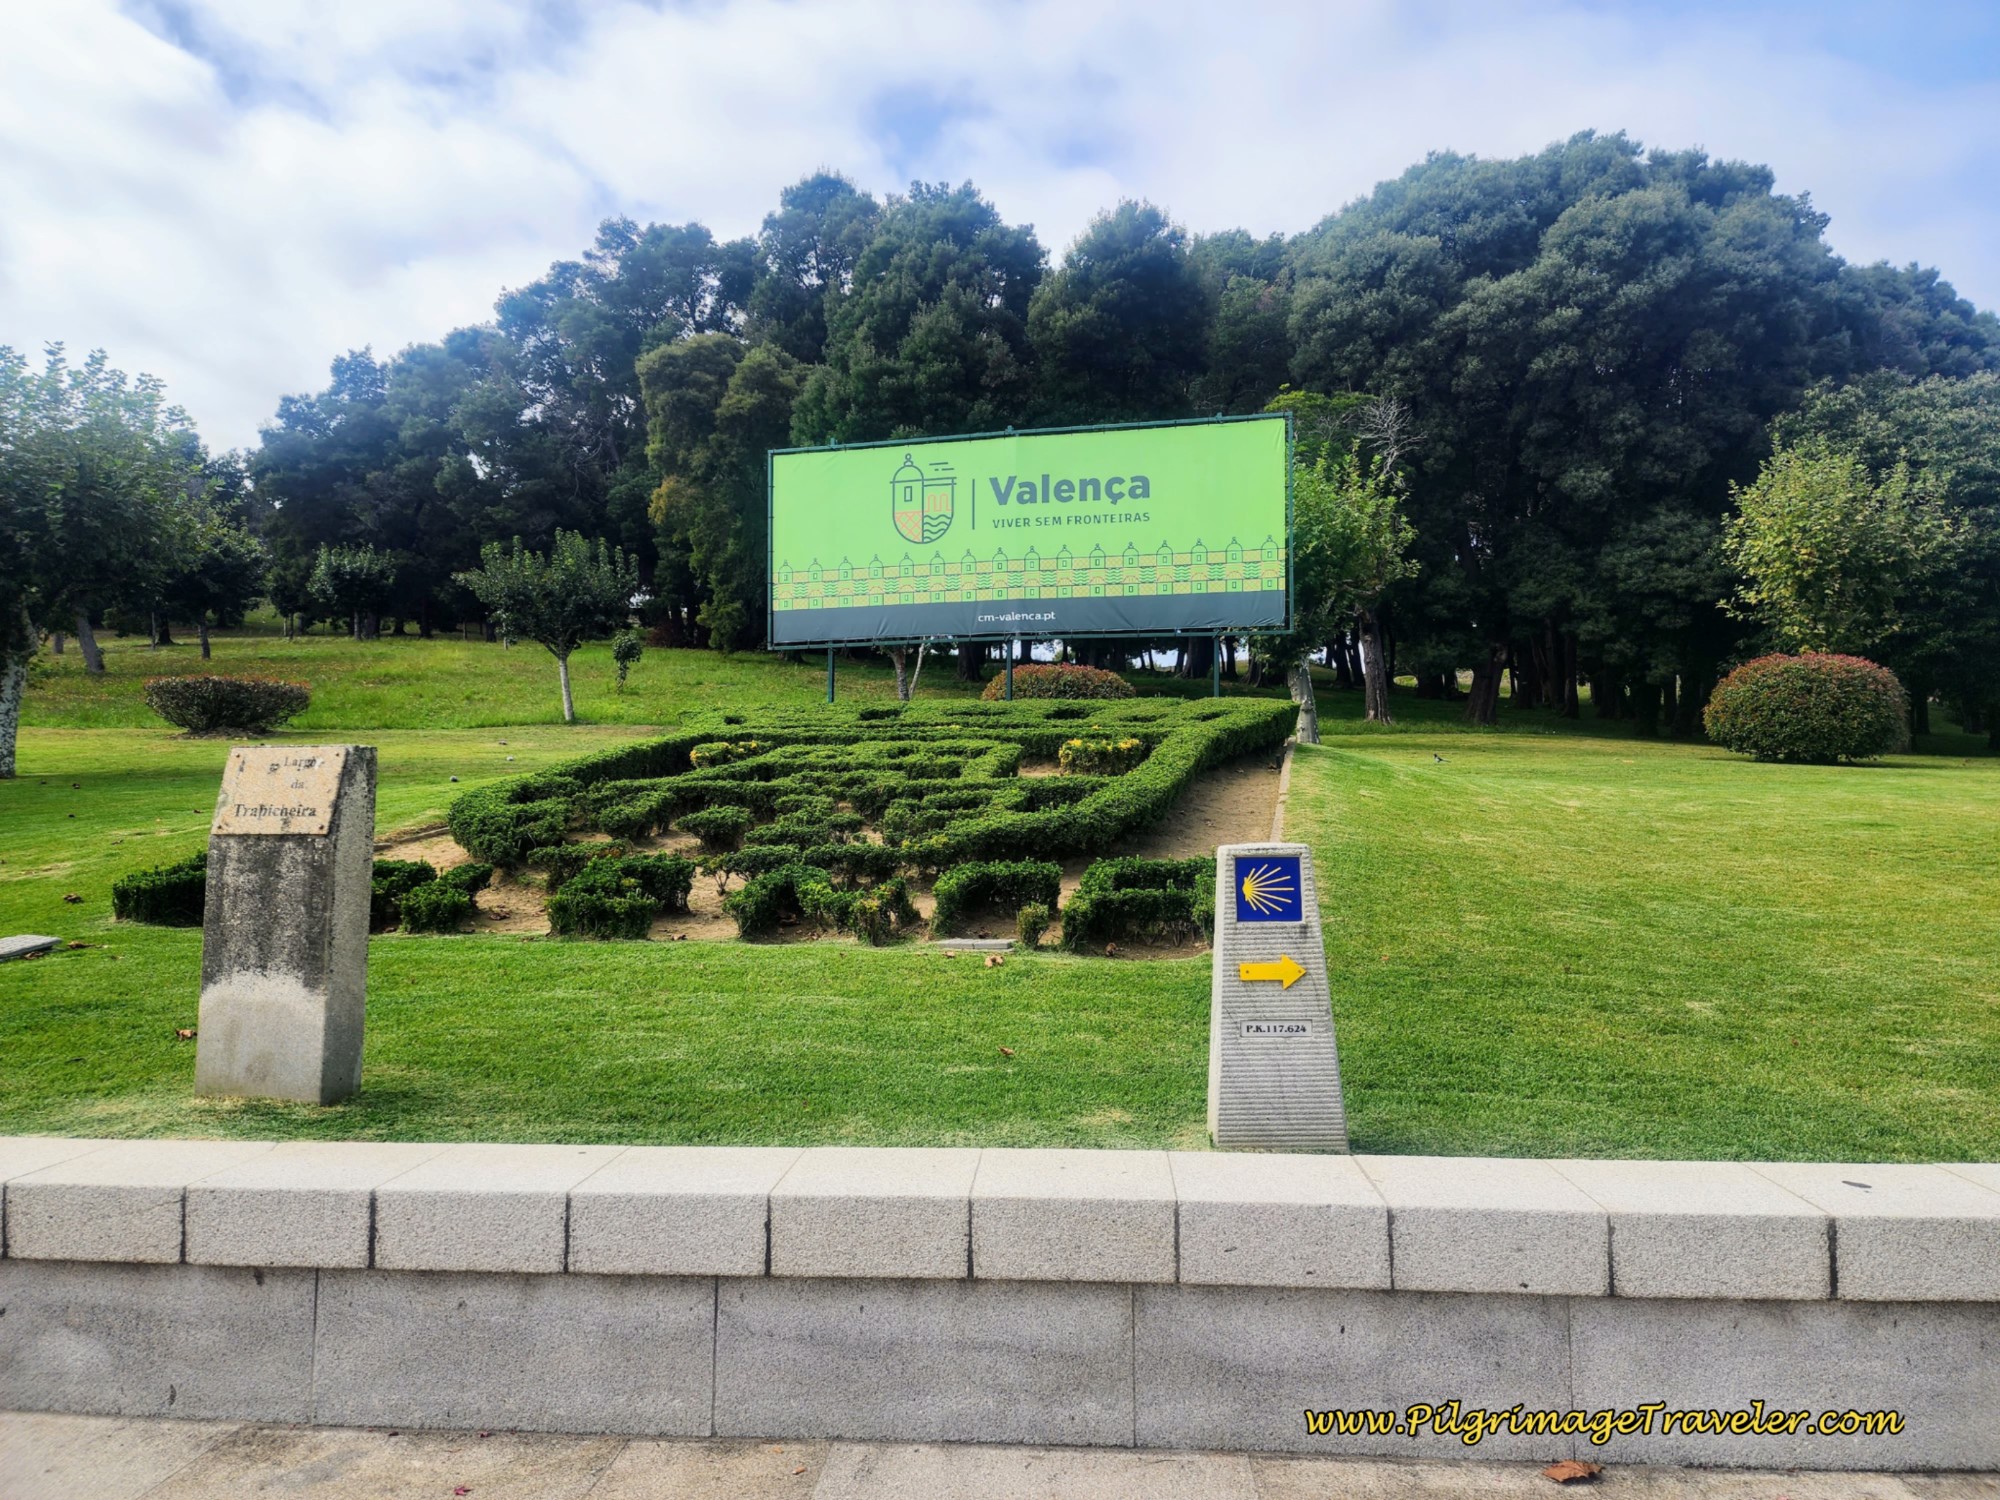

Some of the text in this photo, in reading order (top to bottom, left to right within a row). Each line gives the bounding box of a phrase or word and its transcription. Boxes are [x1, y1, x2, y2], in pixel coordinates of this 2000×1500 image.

[989, 474, 1150, 506] Valença
[992, 512, 1150, 528] VIVER SEM FRONTEIRAS
[978, 611, 1056, 622] cm-valenca.pt
[290, 779, 305, 789] da
[1246, 1024, 1307, 1033] P.K.117.624
